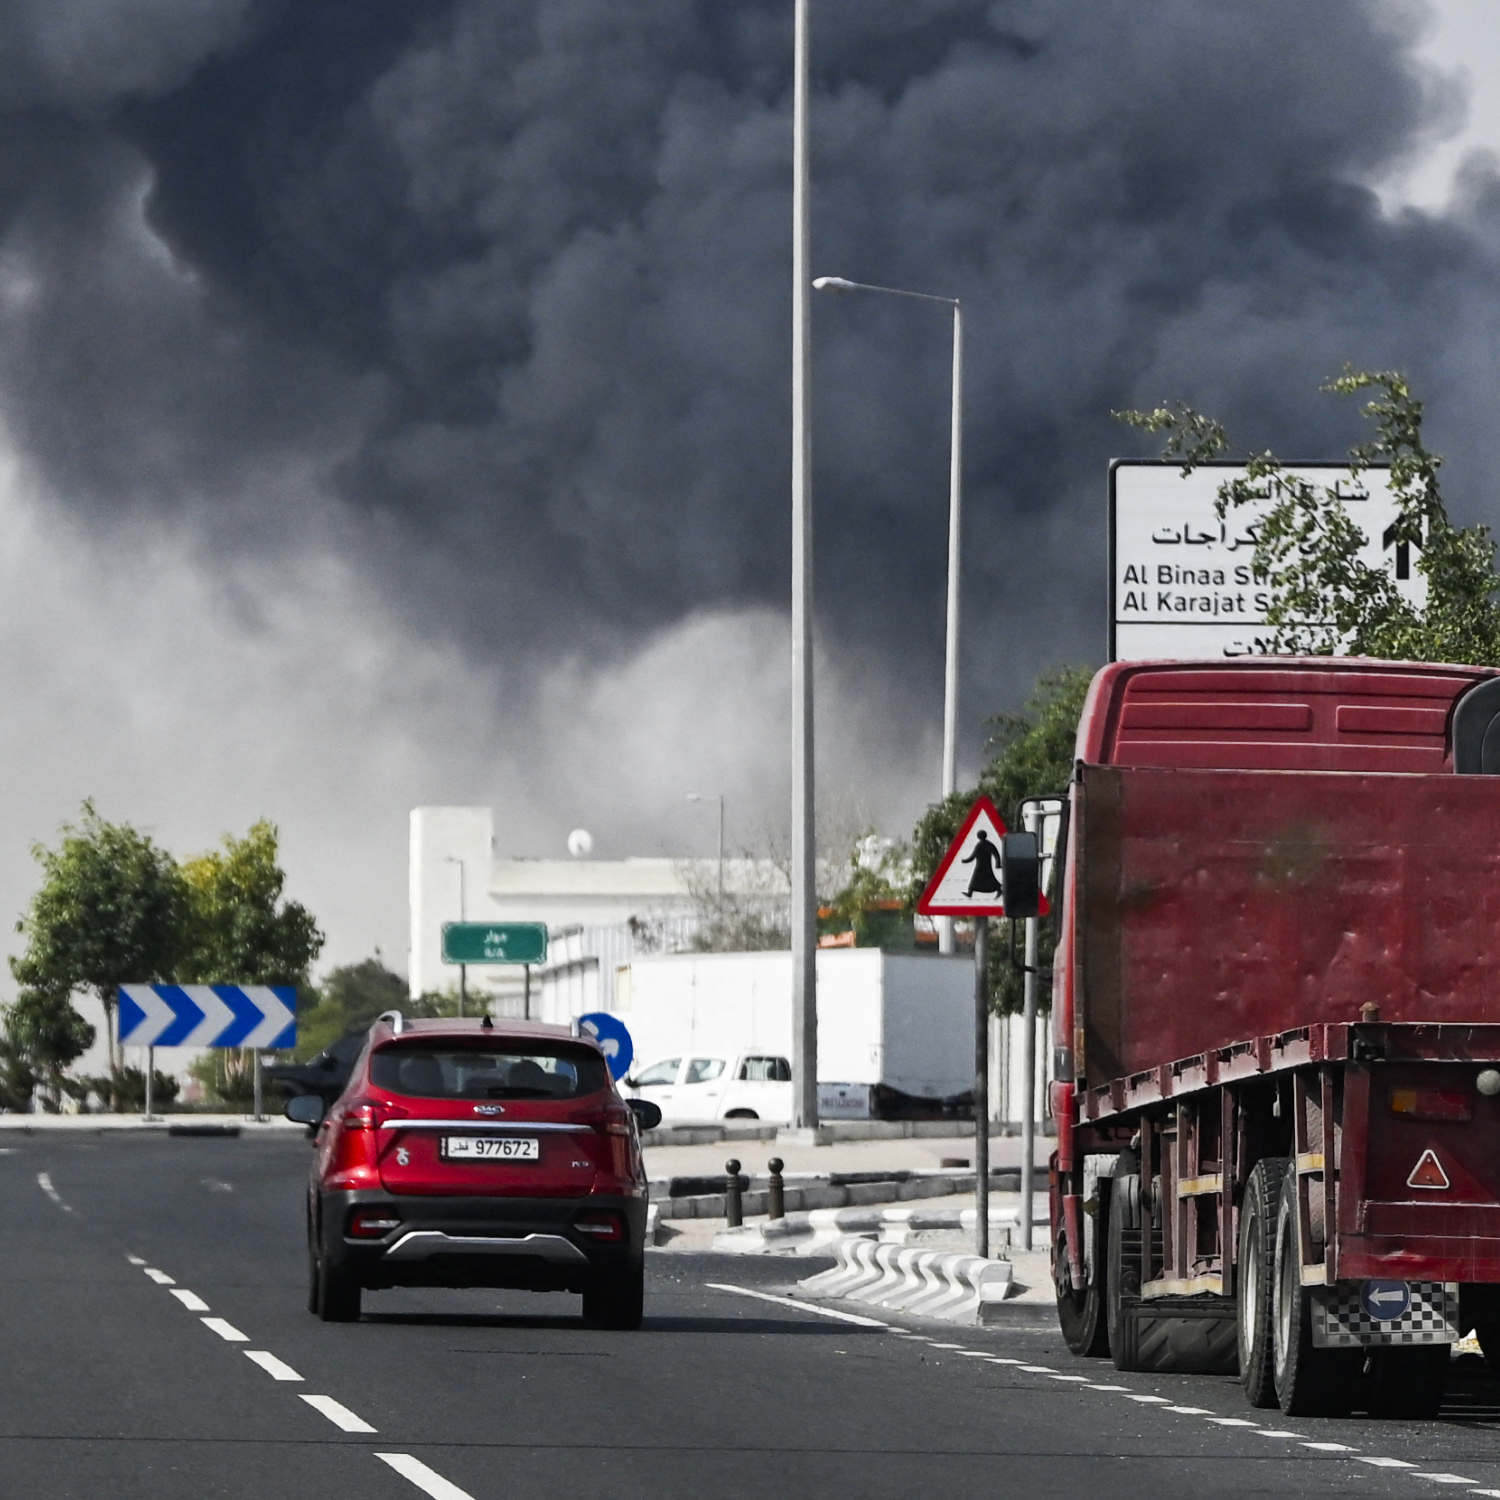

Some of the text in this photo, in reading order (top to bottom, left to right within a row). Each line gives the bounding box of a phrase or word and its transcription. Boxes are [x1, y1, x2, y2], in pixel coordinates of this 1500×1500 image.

[1123, 564, 1148, 585] Al
[1157, 565, 1225, 586] Binaa
[1123, 591, 1148, 612] Al
[1157, 591, 1245, 616] Karajat
[476, 1140, 531, 1156] 977672
